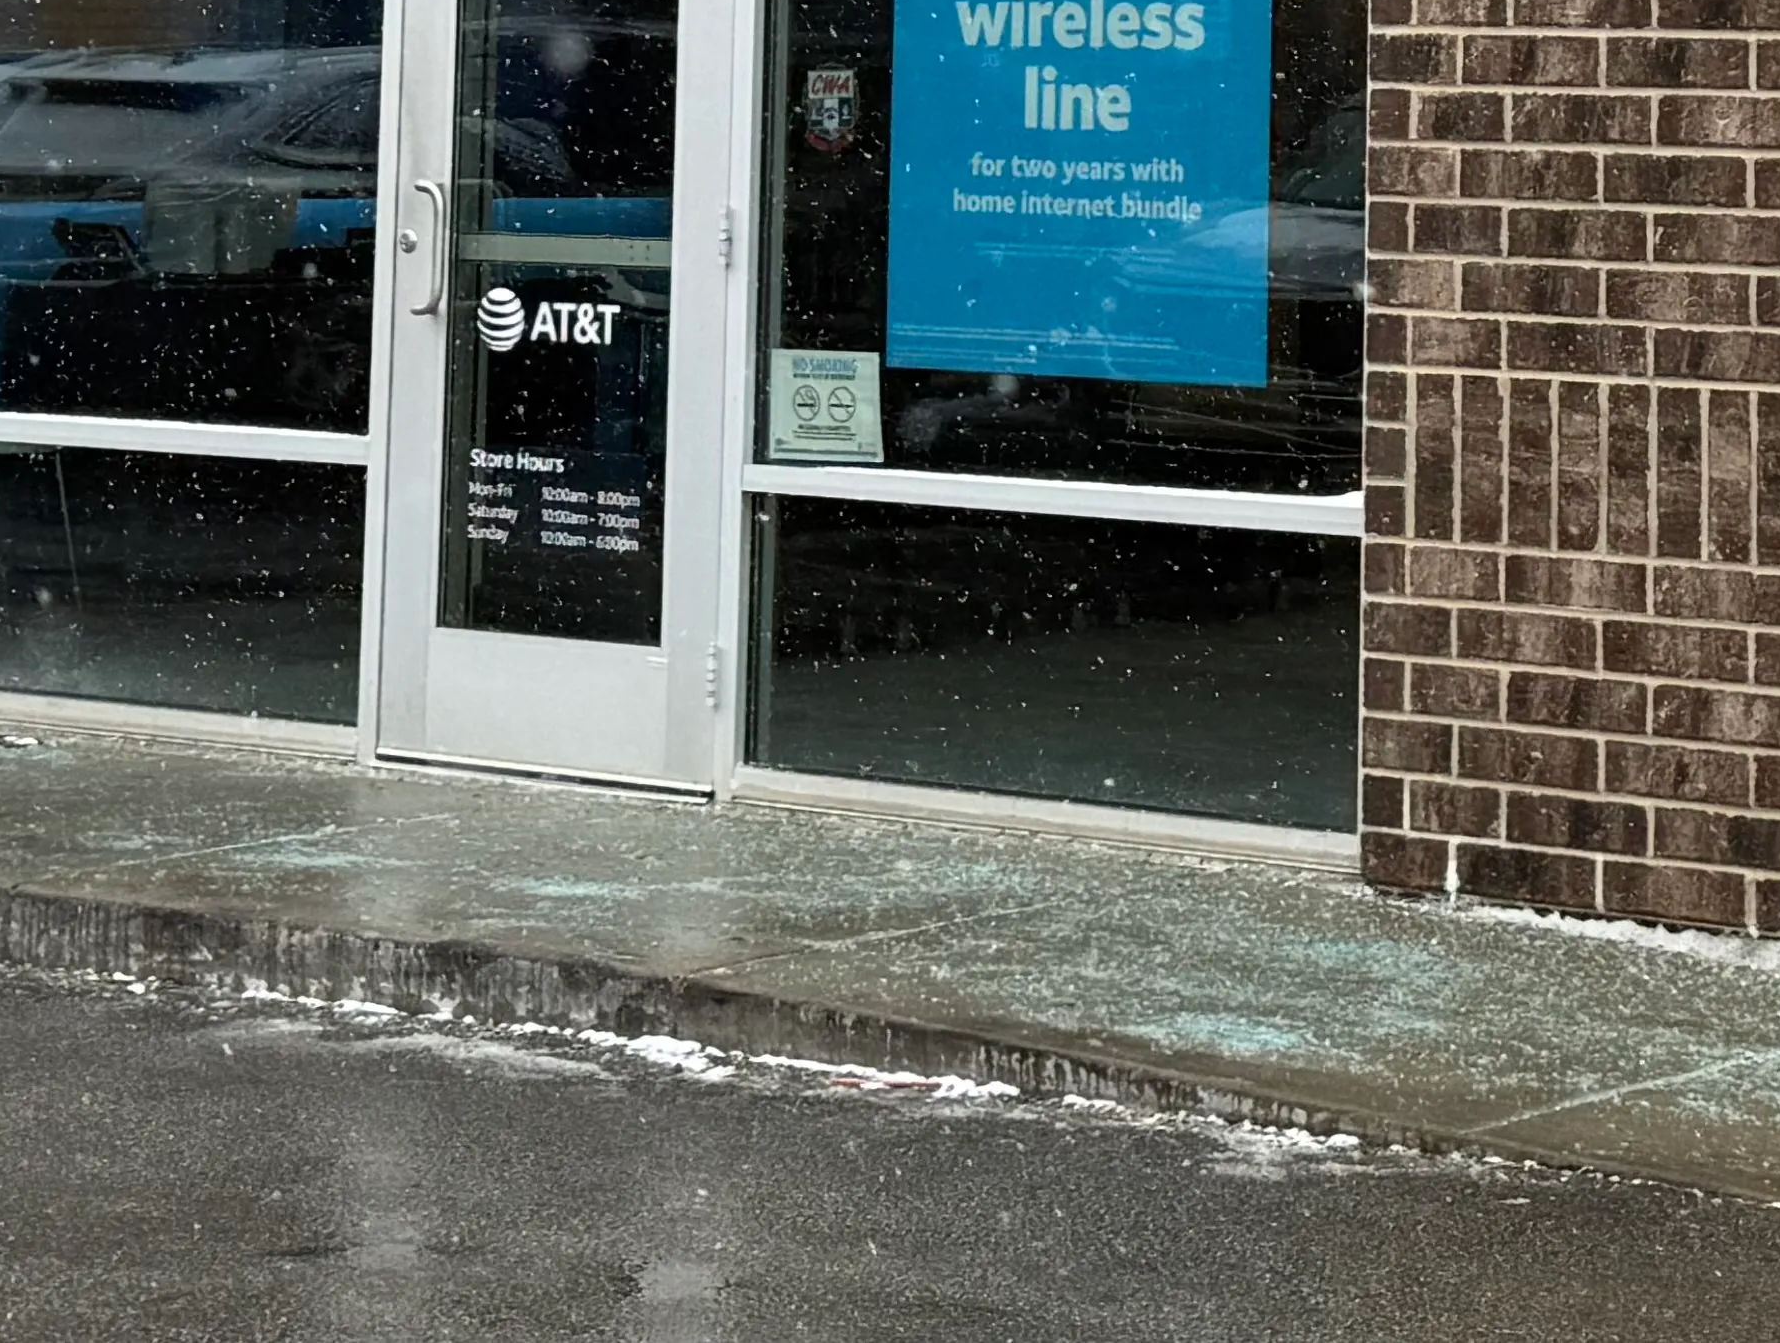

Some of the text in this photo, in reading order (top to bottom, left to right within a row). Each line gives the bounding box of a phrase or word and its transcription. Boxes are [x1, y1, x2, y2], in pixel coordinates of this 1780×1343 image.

[1023, 65, 1132, 132] line
[970, 152, 1184, 185] for two years with
[953, 188, 1202, 222] home internet bundle
[530, 301, 621, 345] AT&T
[469, 448, 565, 473] Store Hours
[467, 502, 519, 524] Saturday
[467, 524, 510, 545] Sunday
